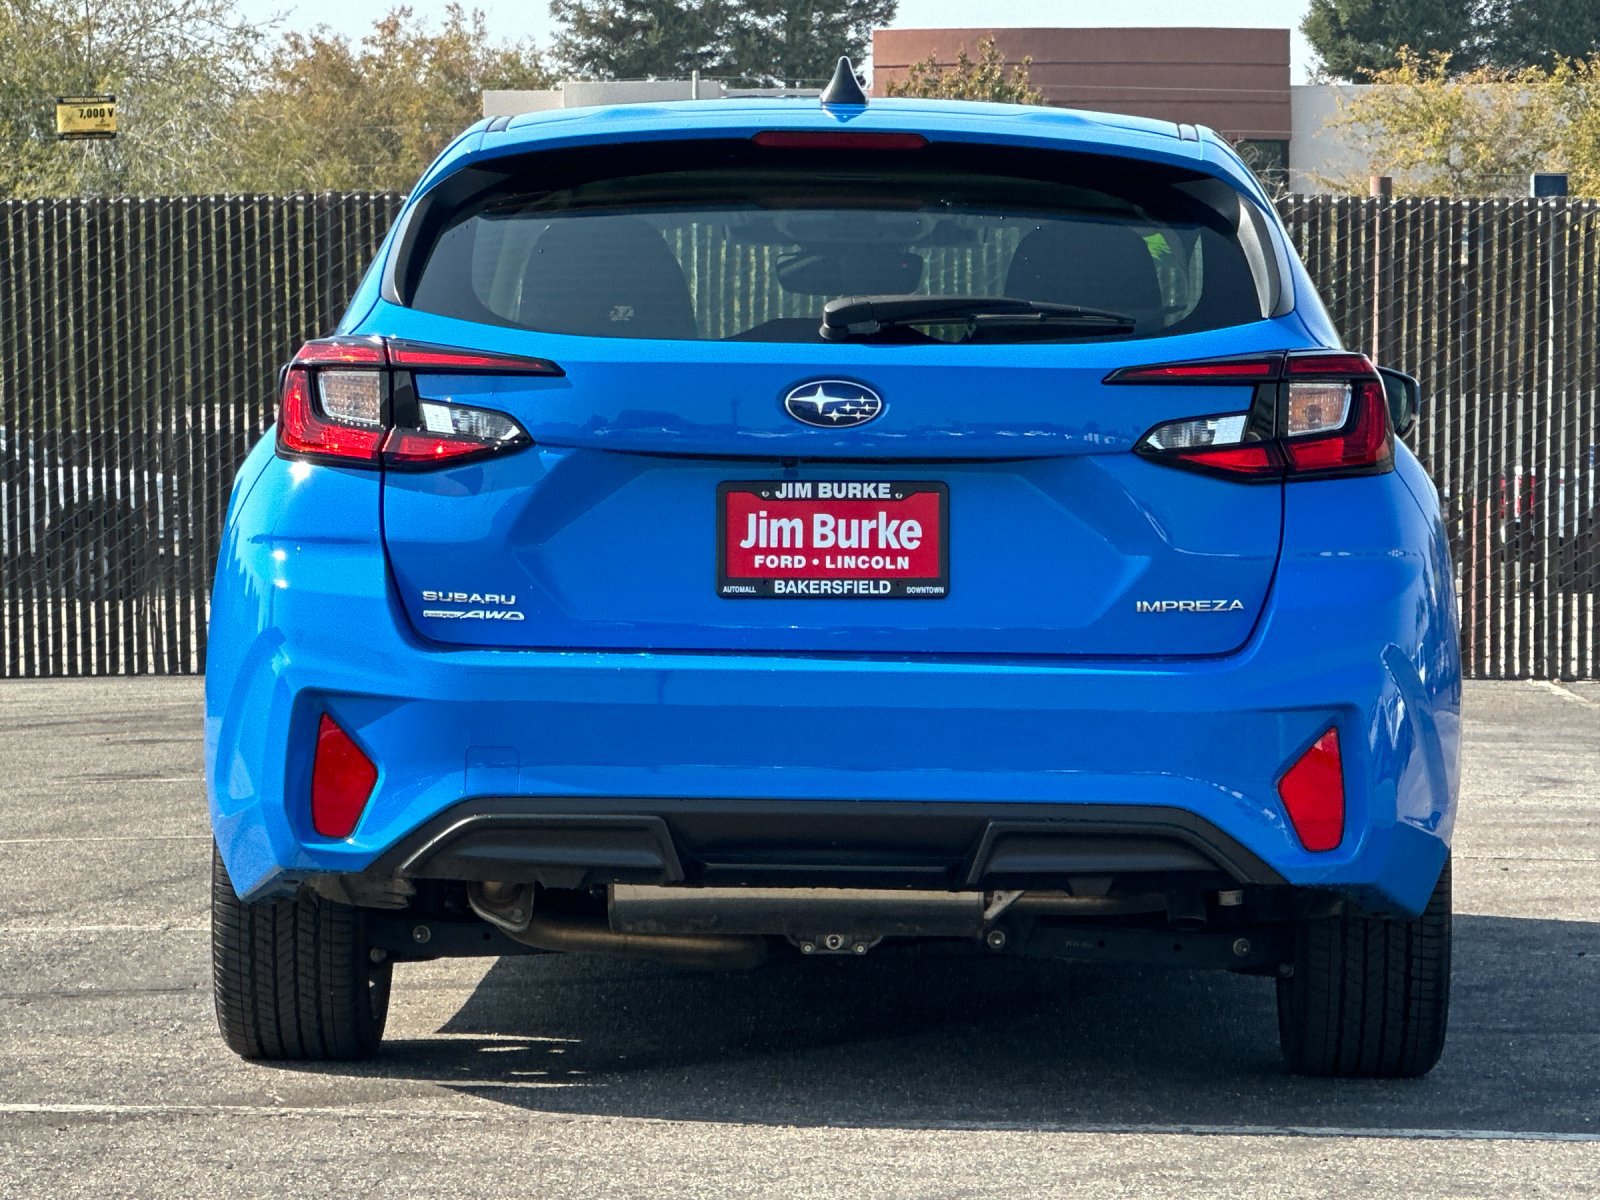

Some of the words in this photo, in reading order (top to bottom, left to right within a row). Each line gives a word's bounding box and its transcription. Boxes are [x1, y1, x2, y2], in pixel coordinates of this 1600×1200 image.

[79, 108, 105, 119] 7,000
[107, 108, 114, 118] V
[775, 483, 812, 499] JIM
[818, 483, 891, 499] BURKE
[739, 511, 804, 549] Jim
[812, 511, 923, 550] Burke
[754, 555, 807, 569] FORD
[825, 555, 909, 570] LINCOLN
[723, 585, 756, 593] AUTOMALL
[774, 580, 892, 595] BAKERSFIELD
[906, 586, 944, 594] DOWNTOWN
[422, 590, 516, 605] SUBARU
[1136, 599, 1245, 613] IMPREZA
[460, 610, 525, 620] AWD
